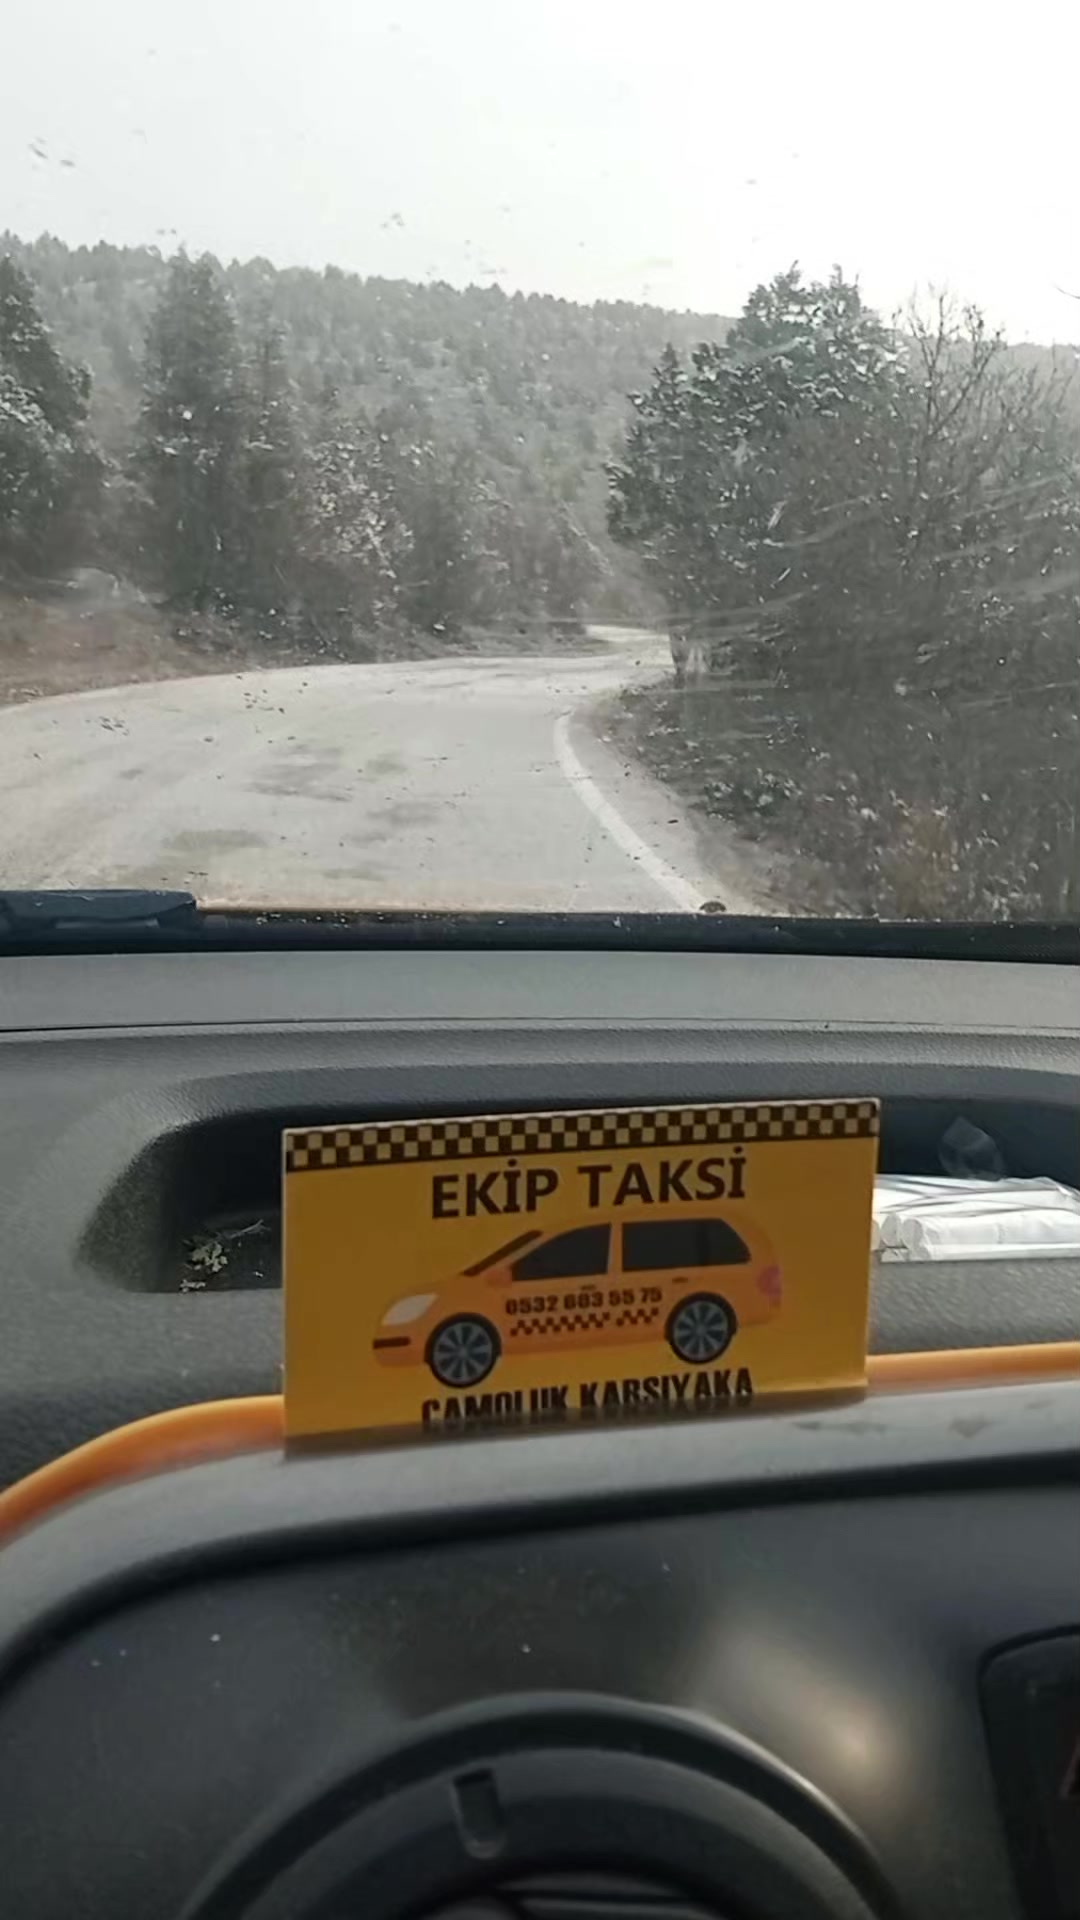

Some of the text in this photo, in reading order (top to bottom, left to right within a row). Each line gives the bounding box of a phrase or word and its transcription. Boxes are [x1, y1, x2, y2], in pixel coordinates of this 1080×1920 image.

[431, 1146, 747, 1220] EKİP TAKSİ
[505, 1295, 558, 1315] 0532
